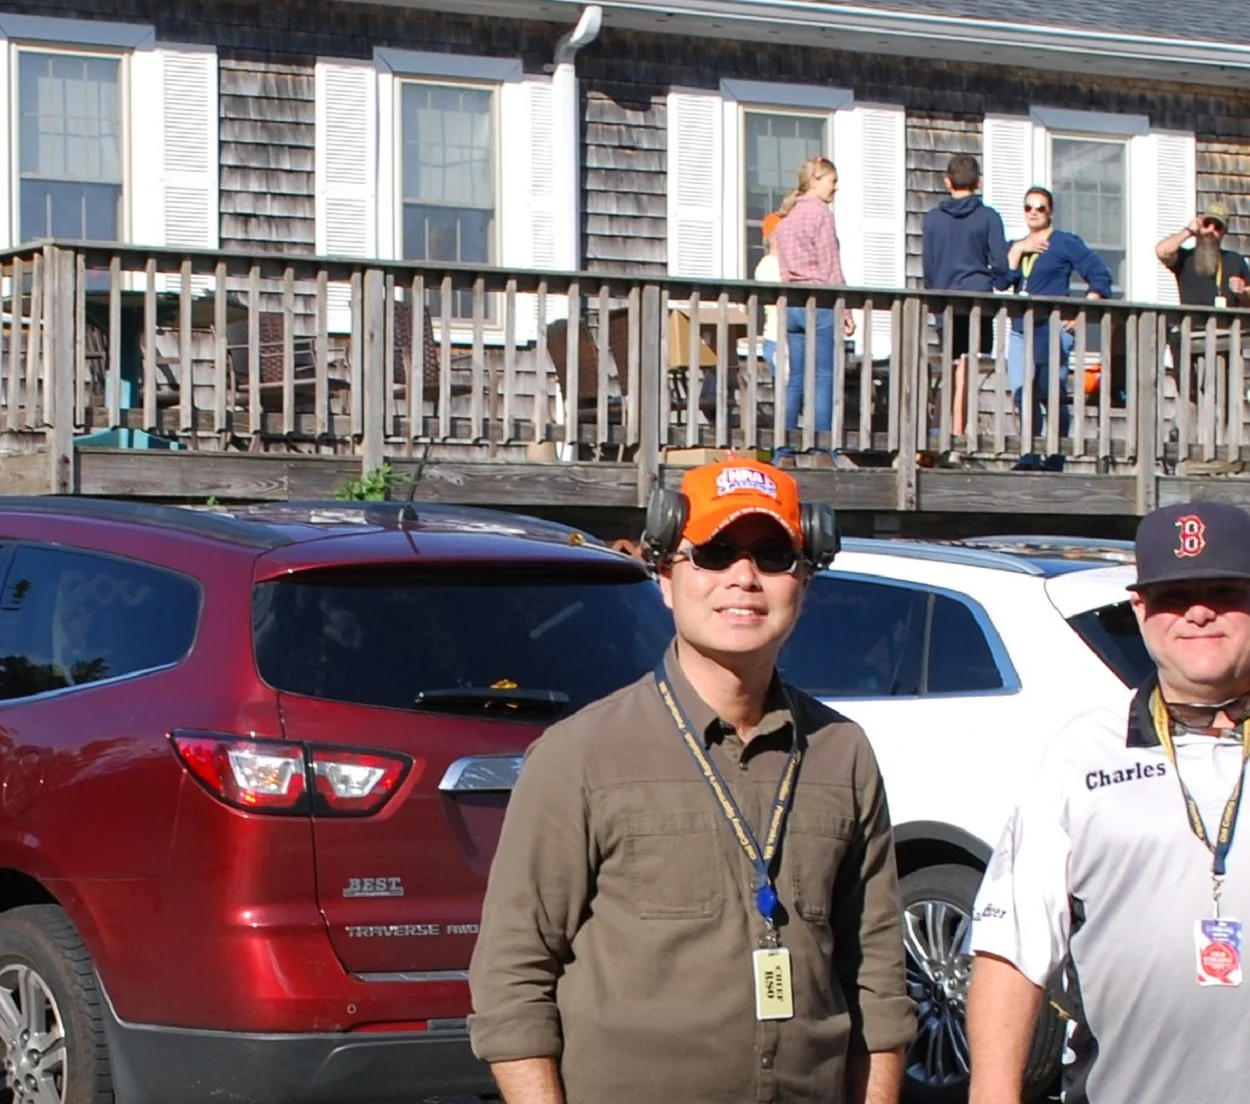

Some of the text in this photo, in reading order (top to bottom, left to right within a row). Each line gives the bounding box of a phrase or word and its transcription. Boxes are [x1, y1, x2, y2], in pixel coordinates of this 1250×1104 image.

[1174, 515, 1206, 558] B
[1085, 762, 1167, 791] Charles
[348, 877, 402, 892] BEST
[344, 924, 480, 937] TRAVERSE AWD
